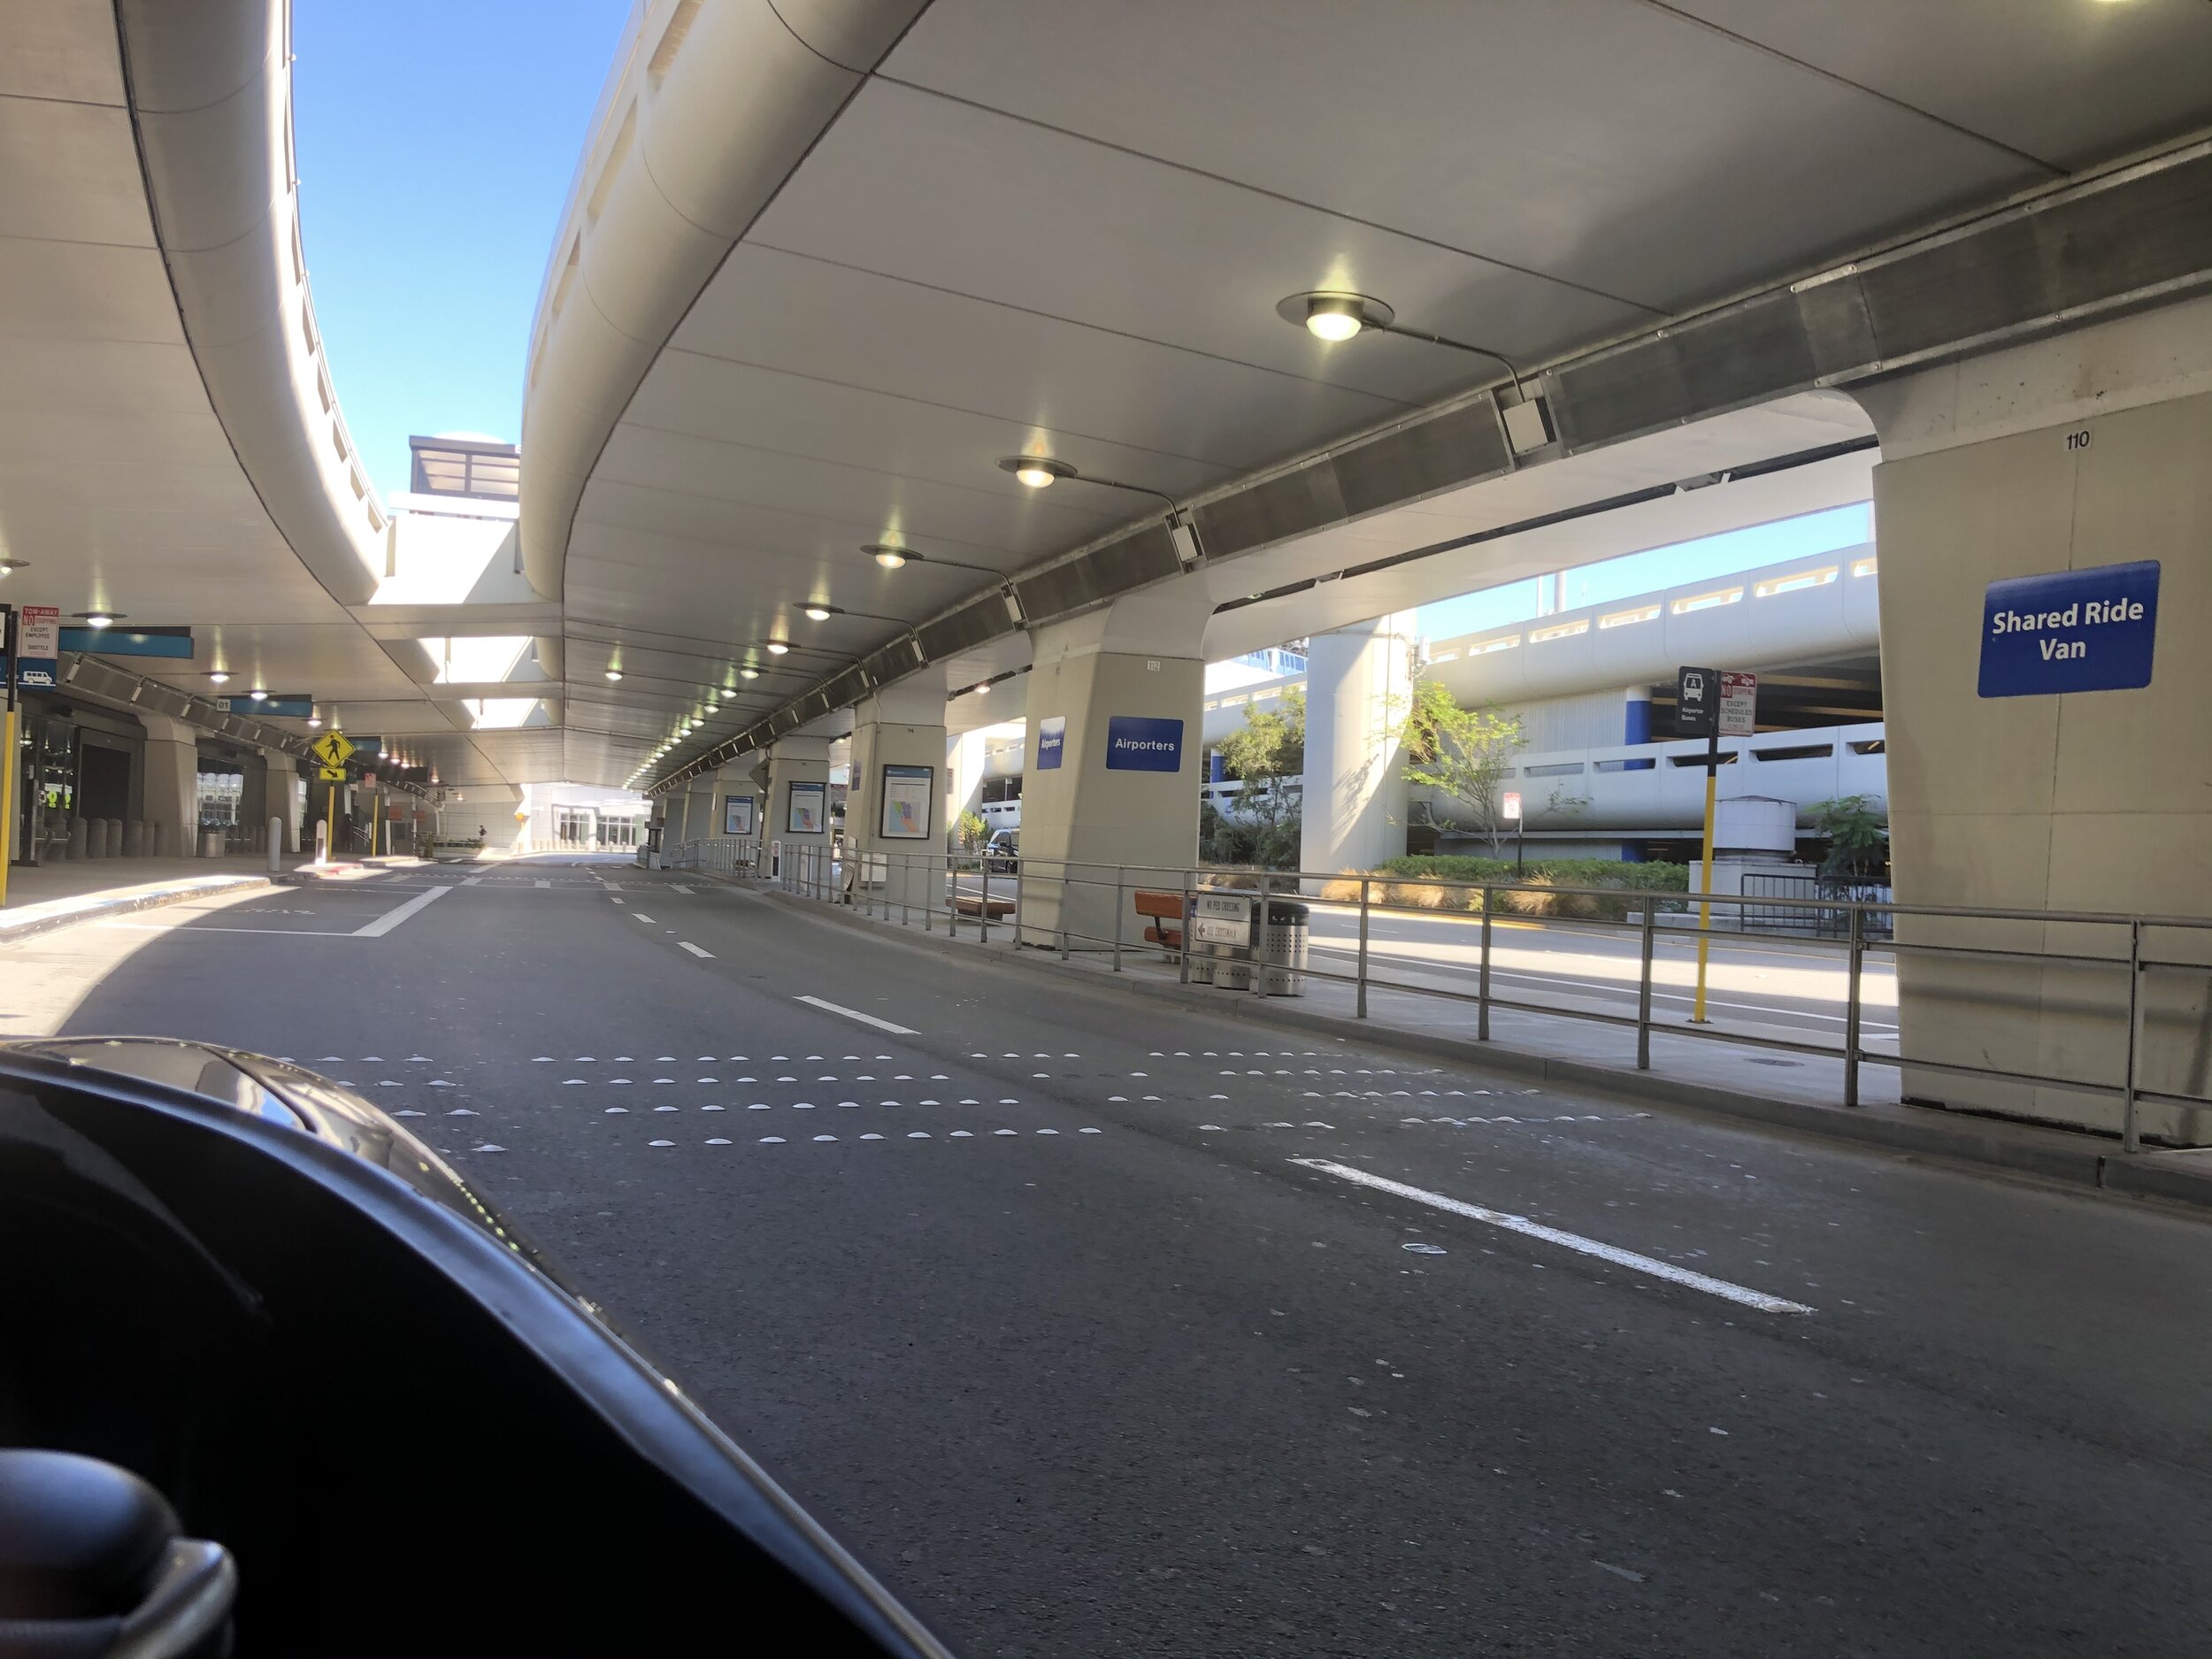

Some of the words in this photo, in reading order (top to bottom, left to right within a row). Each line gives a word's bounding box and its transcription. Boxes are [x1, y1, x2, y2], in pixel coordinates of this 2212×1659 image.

[2067, 430, 2090, 449] 110
[23, 615, 34, 625] NO
[1993, 603, 2078, 634] Shared
[2085, 597, 2144, 625] Ride
[2039, 638, 2086, 661] Van
[1690, 679, 1697, 688] A
[1721, 684, 1732, 697] NO
[1041, 737, 1061, 751] Airporters
[1115, 737, 1175, 751] Airporters
